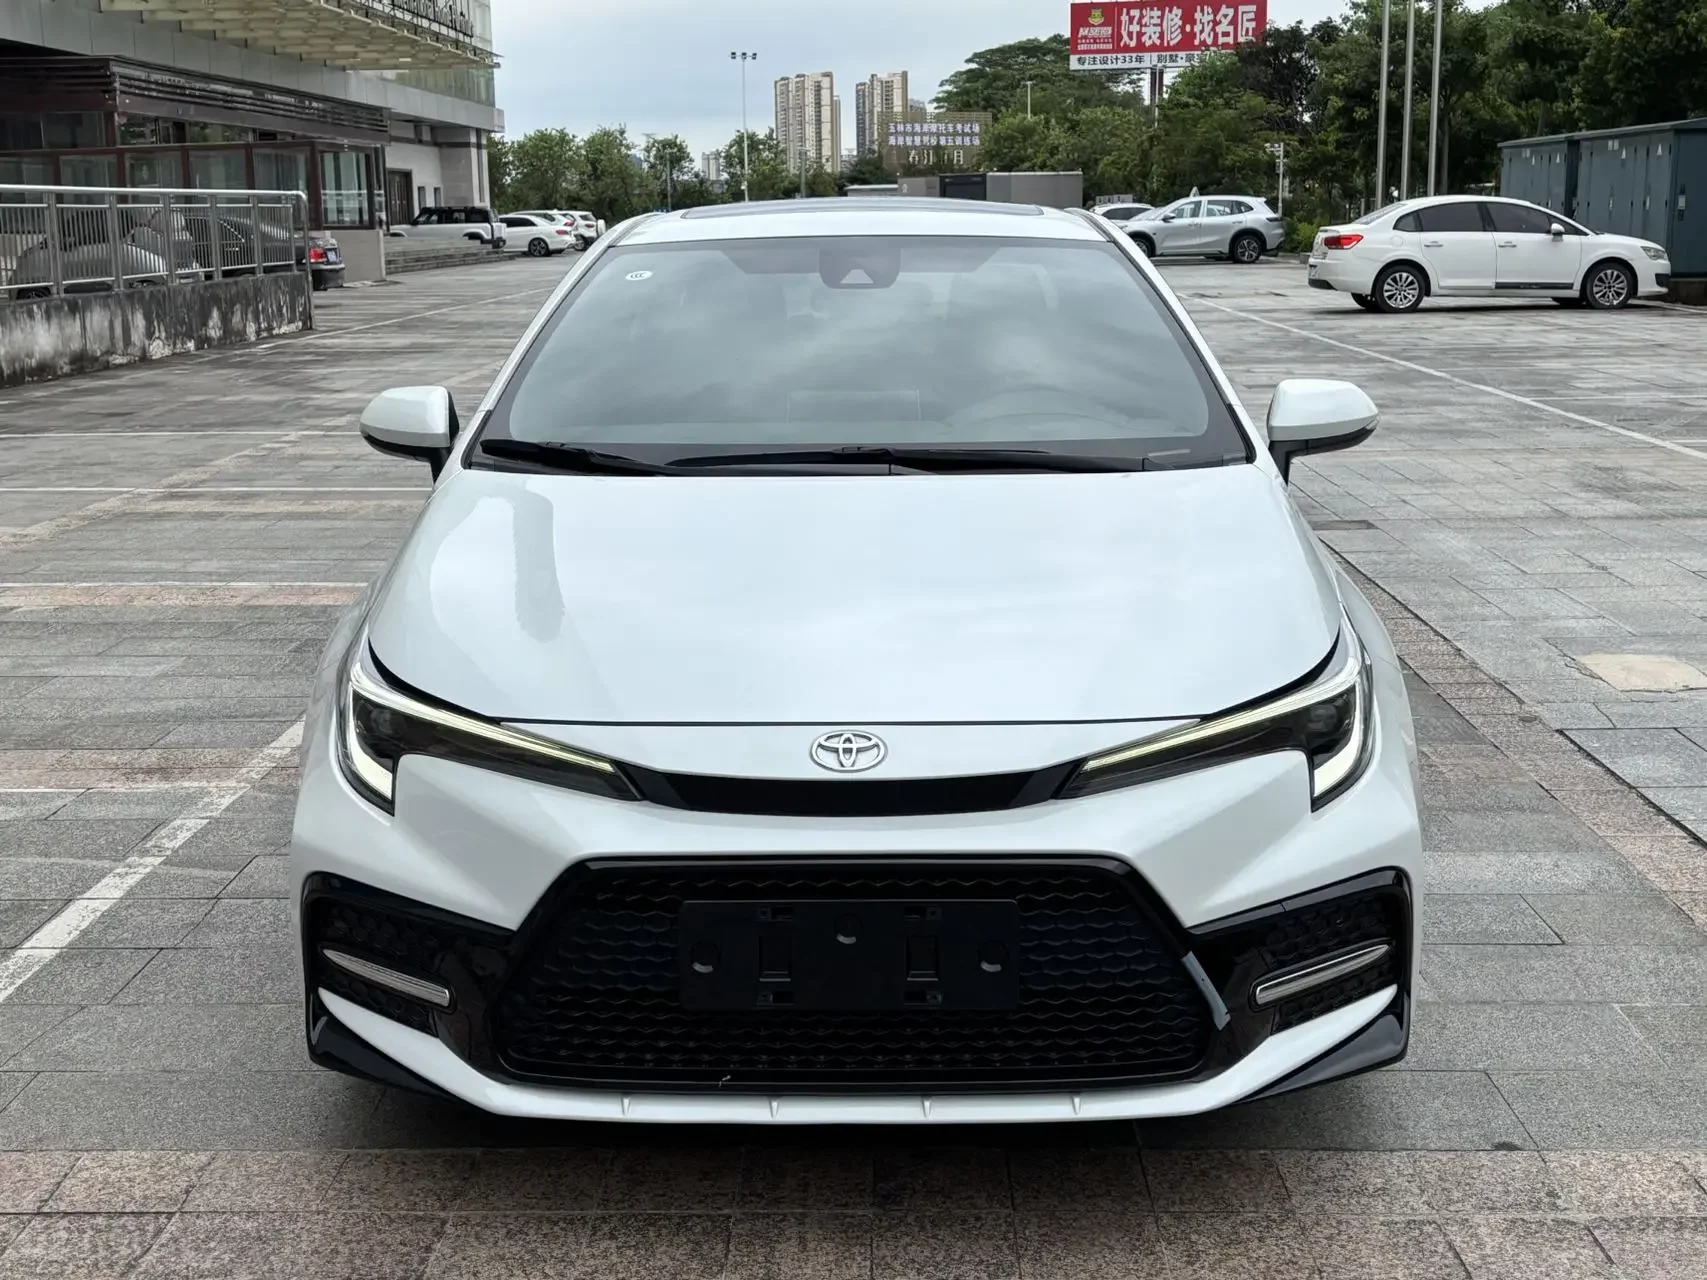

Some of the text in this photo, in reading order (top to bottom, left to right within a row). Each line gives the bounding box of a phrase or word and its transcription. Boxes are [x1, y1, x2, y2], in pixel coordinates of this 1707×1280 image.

[1120, 4, 1257, 48] 好装修·找名匠
[1077, 53, 1145, 66] 专注设计33年
